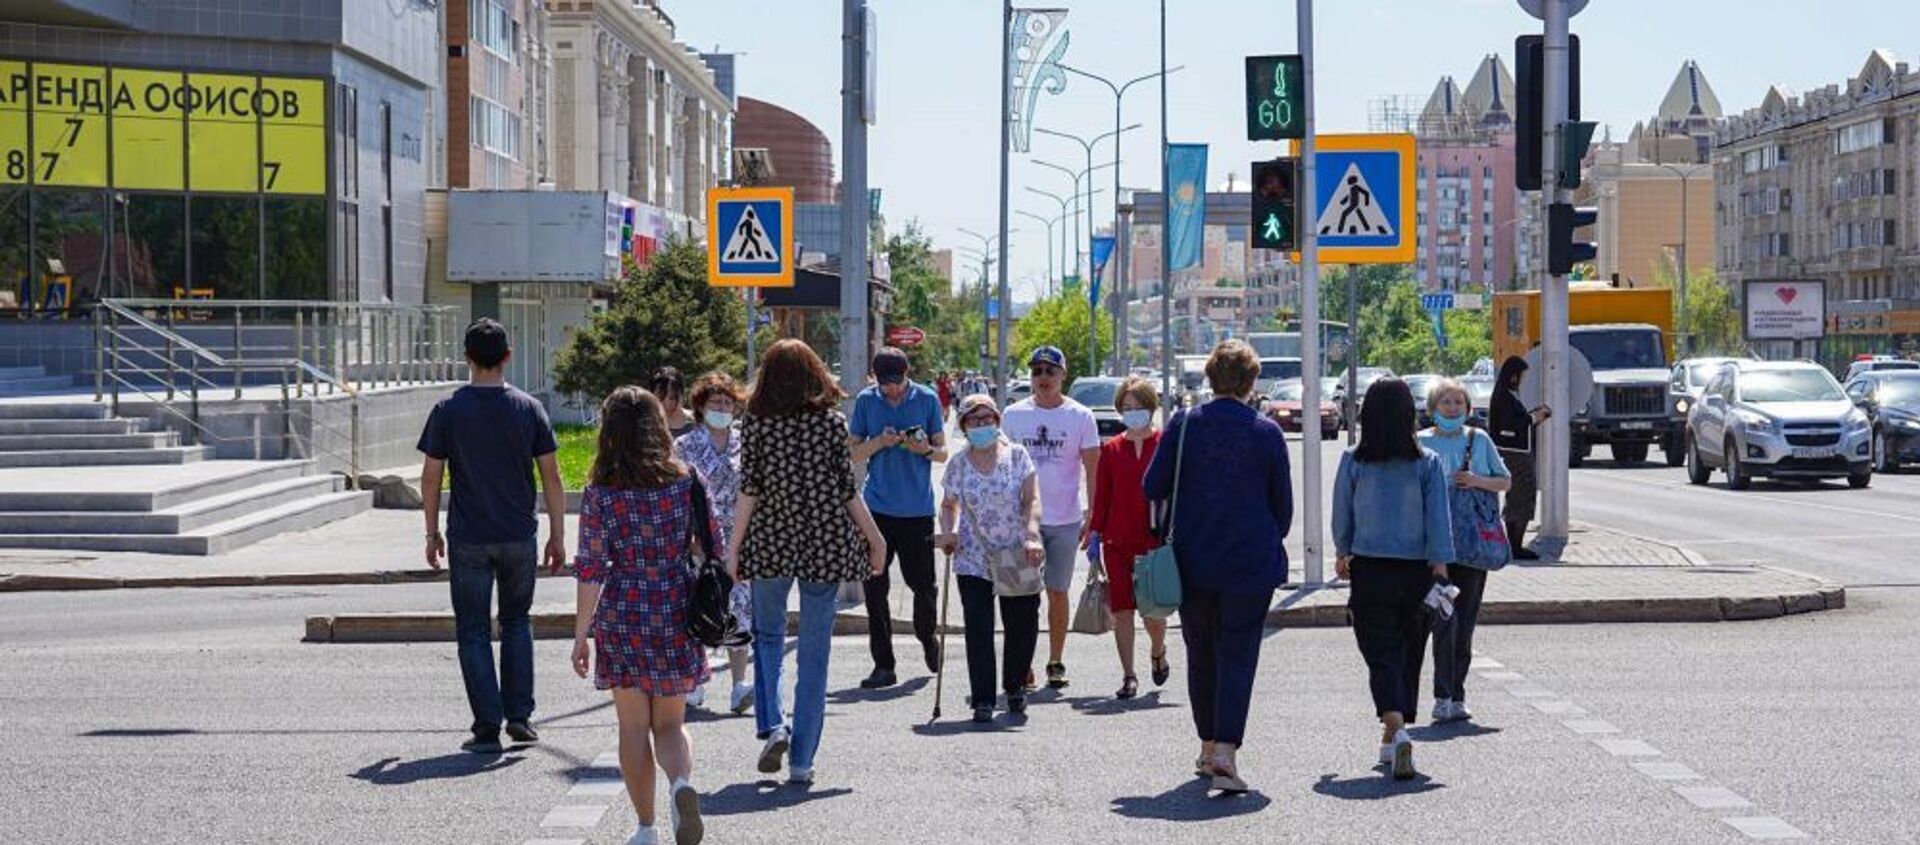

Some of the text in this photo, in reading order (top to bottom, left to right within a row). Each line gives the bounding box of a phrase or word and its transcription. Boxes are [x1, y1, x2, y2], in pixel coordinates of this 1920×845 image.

[145, 82, 300, 118] ОФИСОВ
[65, 118, 84, 147] 7
[263, 163, 281, 190] 7
